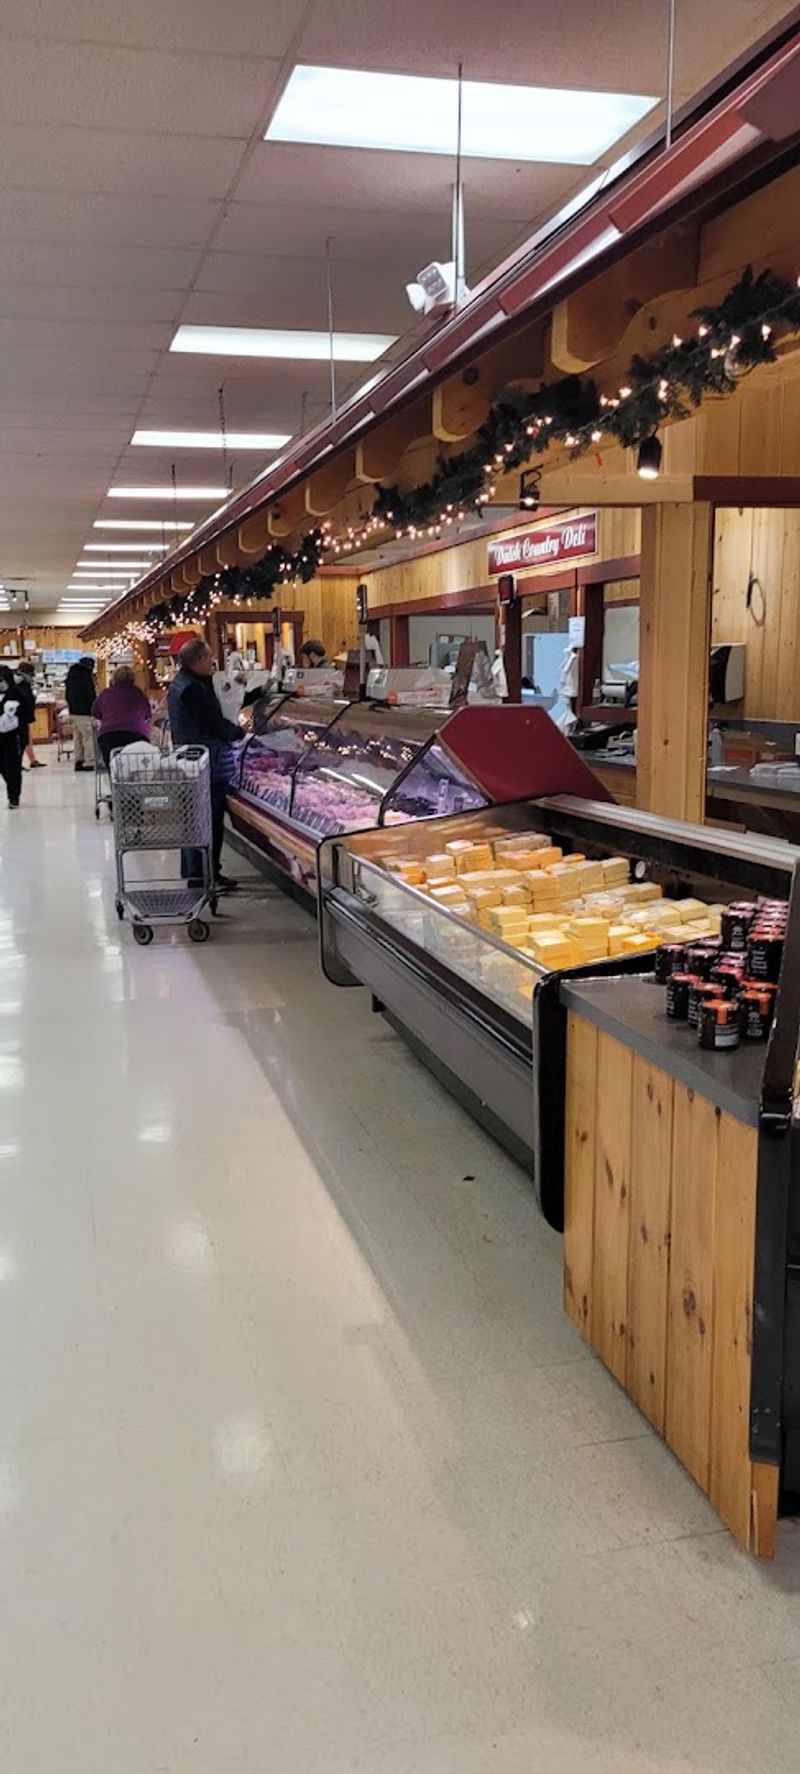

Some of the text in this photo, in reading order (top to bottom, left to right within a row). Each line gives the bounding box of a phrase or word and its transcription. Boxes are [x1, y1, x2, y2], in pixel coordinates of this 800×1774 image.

[494, 523, 587, 566] Dutch Country Deli
